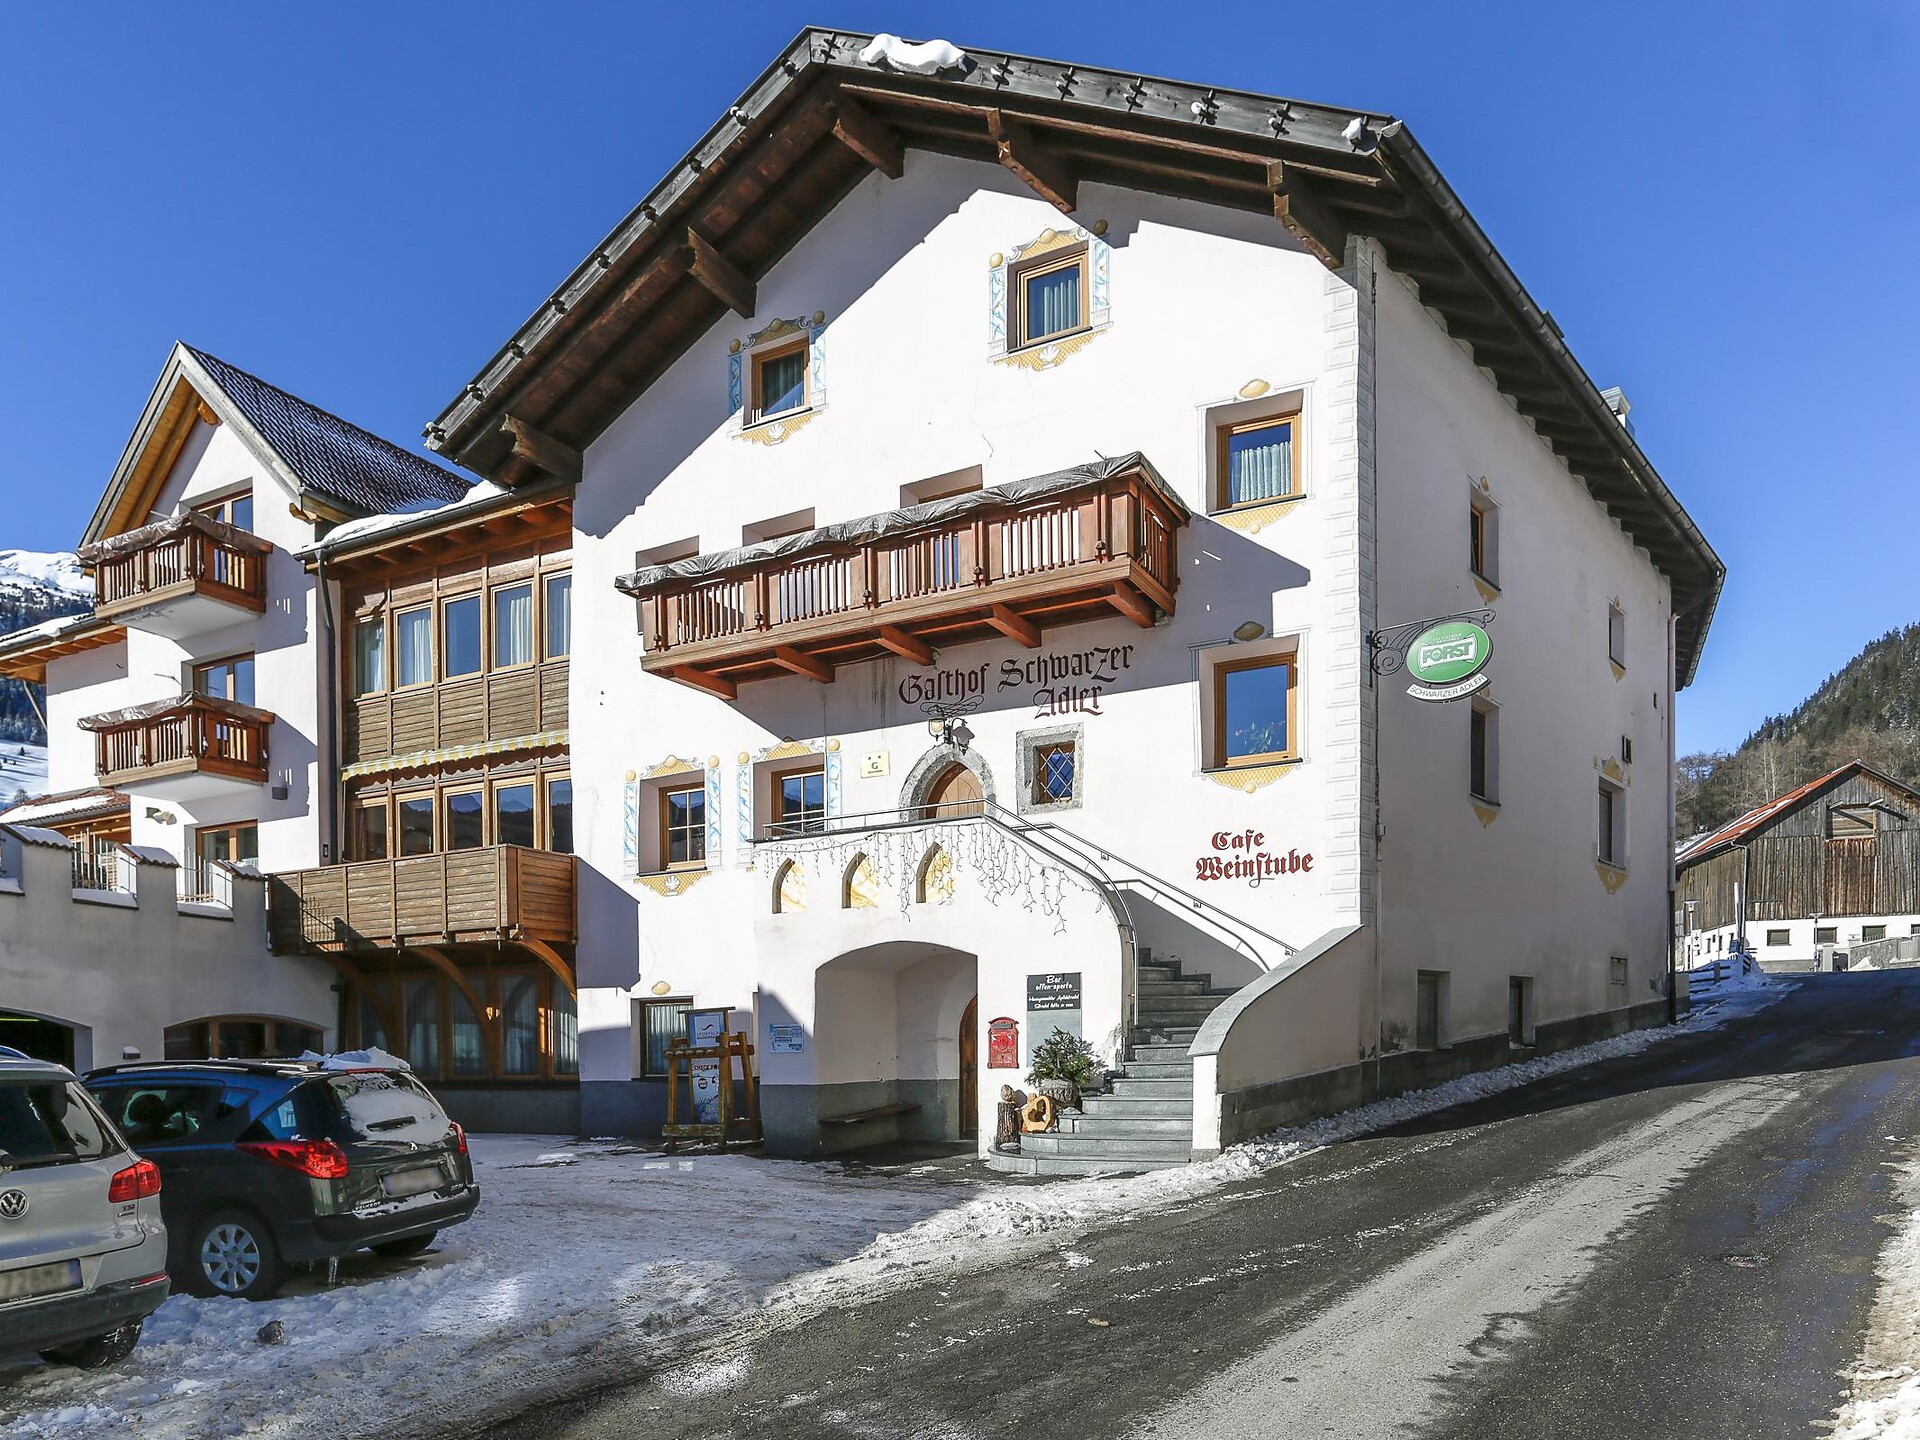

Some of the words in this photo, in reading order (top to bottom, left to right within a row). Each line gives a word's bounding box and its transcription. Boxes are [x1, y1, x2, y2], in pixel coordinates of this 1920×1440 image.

[1422, 642, 1472, 663] FORST
[1409, 684, 1459, 698] SCHWARZER
[1459, 675, 1485, 692] ADLER
[1032, 685, 1104, 720] Adler
[1211, 829, 1265, 854] Cafe
[1046, 975, 1061, 983] Bar
